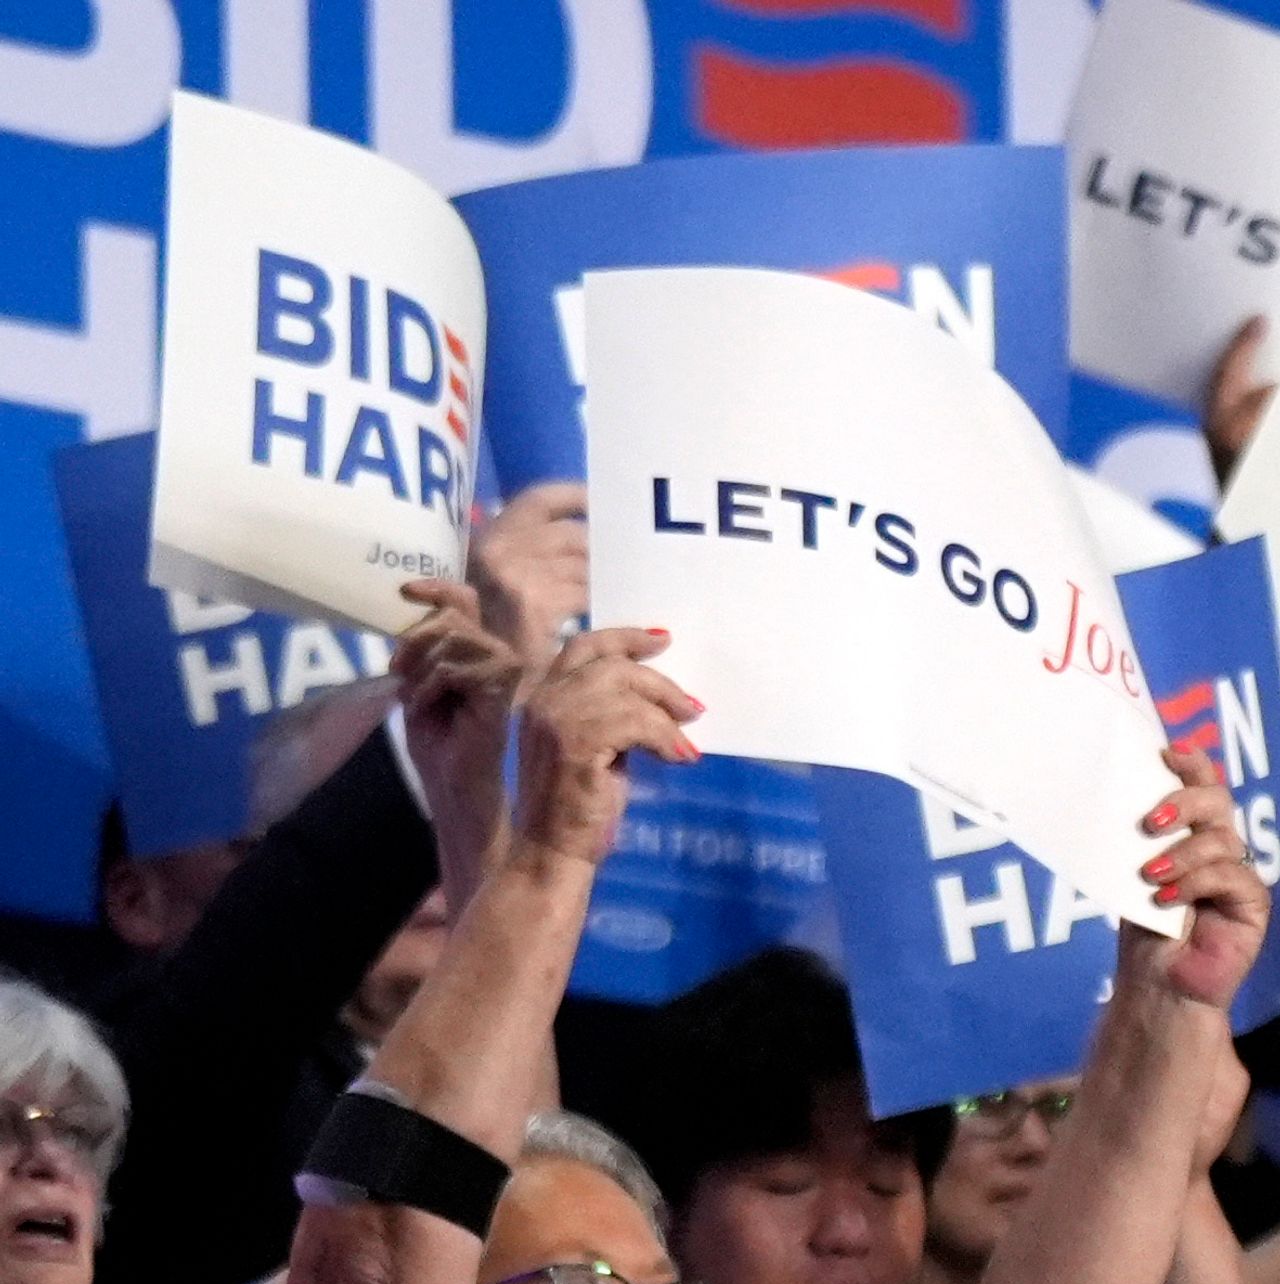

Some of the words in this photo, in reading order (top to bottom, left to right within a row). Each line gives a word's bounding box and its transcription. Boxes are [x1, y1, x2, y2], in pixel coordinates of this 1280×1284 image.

[256, 246, 472, 446] BIDE
[653, 476, 920, 579] LET'S
[941, 542, 1040, 634] GO
[1043, 579, 1142, 700] Joe
